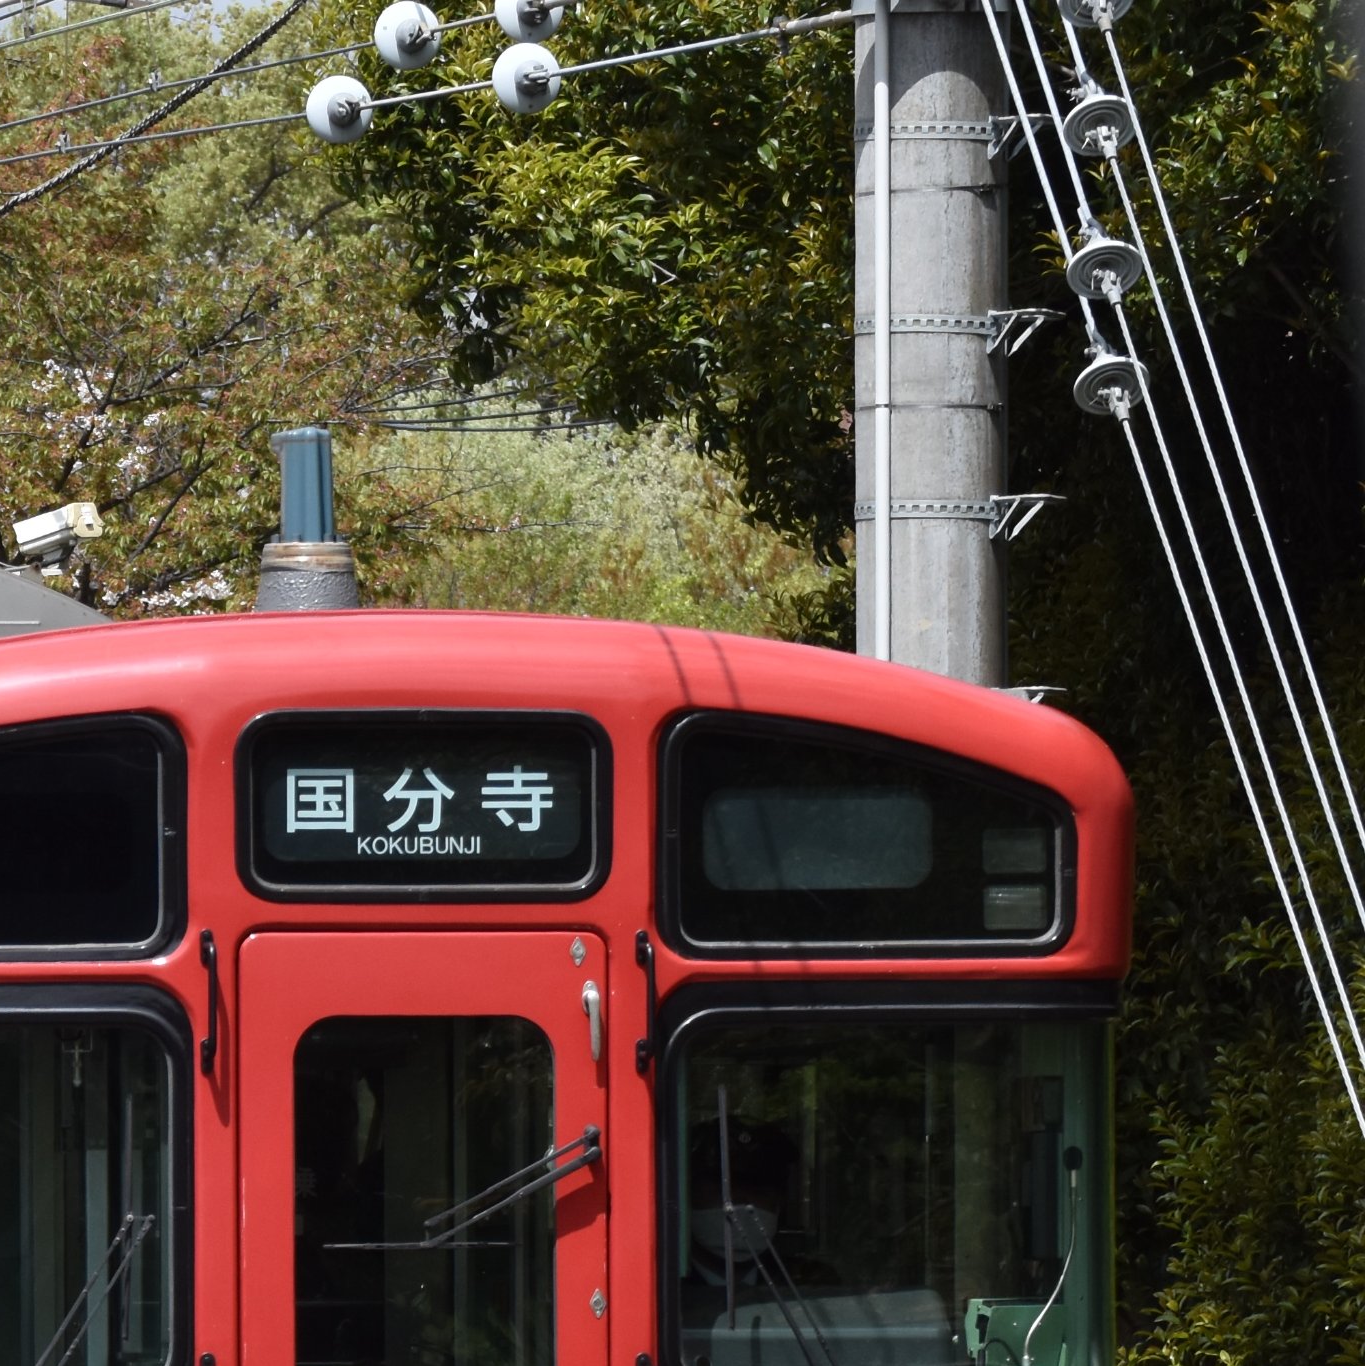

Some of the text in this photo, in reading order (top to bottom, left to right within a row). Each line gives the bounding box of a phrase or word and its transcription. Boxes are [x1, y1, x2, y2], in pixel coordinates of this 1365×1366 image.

[286, 765, 554, 833] 国分寺
[357, 836, 481, 855] KOKUBUNJI
